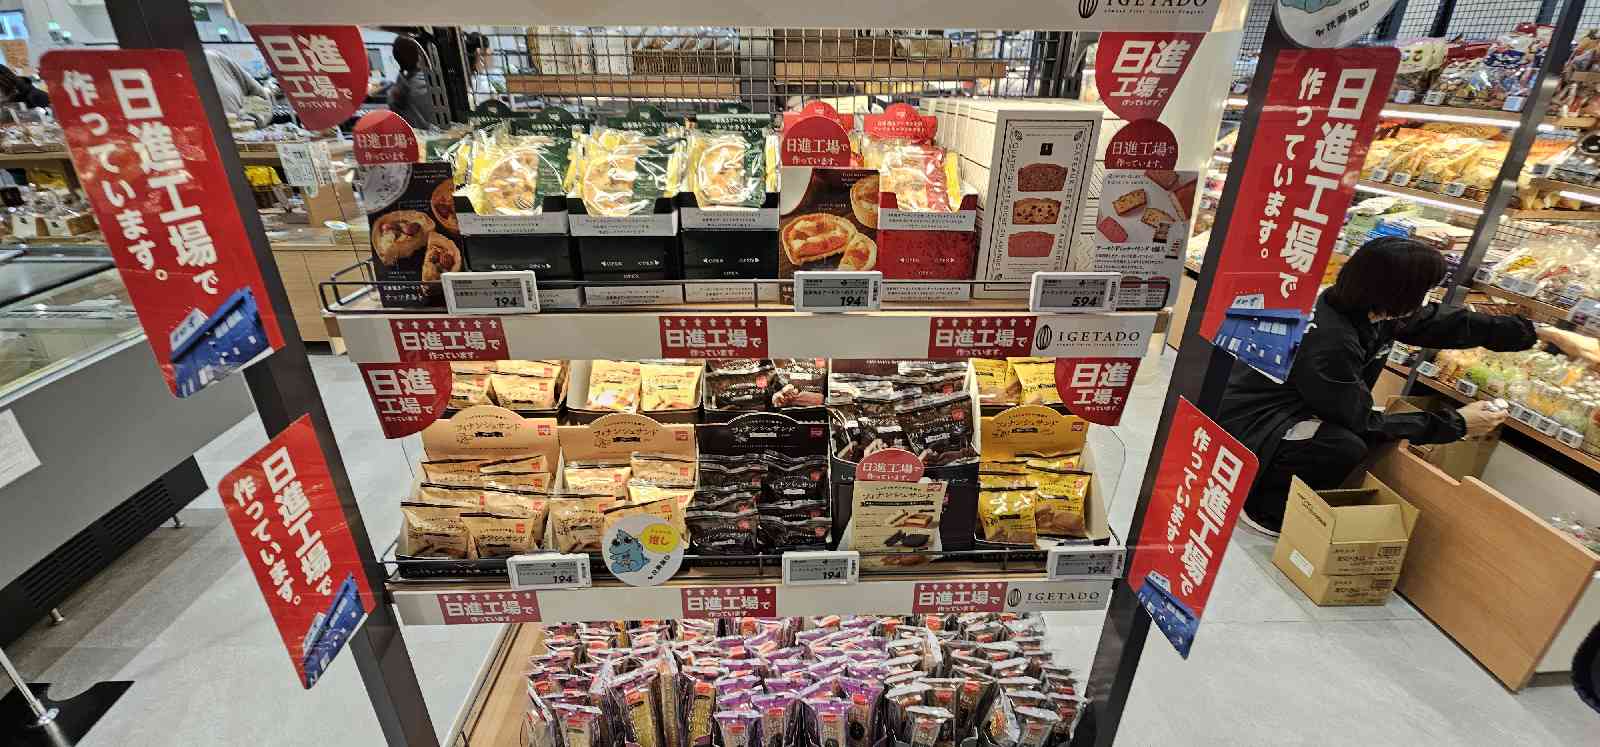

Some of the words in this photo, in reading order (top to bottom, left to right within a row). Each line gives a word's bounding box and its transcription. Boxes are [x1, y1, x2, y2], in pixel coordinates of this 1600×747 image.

[261, 35, 351, 74] 日進
[1112, 40, 1191, 75] 日進
[287, 76, 353, 101] 工場で
[1110, 77, 1168, 98] 工場で
[355, 132, 415, 149] 日進工場で
[786, 138, 848, 155] 日進工場で
[1111, 142, 1175, 157] 日進工場で
[1258, 68, 1324, 259] 作っています。
[63, 70, 169, 282] 作っています。
[109, 68, 221, 295] 日進工場で
[1279, 68, 1377, 297] 日進工場で
[495, 297, 518, 307] 194
[840, 296, 861, 306] 194
[1072, 297, 1098, 306] 594
[400, 331, 501, 352] 日進工場で
[665, 330, 762, 350] 日進工場で
[934, 328, 1028, 348] 日進工場で
[1058, 331, 1140, 342] IGETADO
[428, 352, 479, 361] 作っています。
[690, 350, 738, 358] 作っています。
[957, 349, 1005, 357] 作っています。
[367, 368, 437, 397] 日進
[1071, 361, 1132, 388] 日進
[377, 398, 434, 415] 工場で
[1073, 390, 1122, 405] 工場で
[1167, 427, 1213, 555] 作っています。
[262, 446, 332, 596] 日進工場で
[1180, 445, 1244, 597] 日進工場で
[233, 475, 302, 606] 作っています。
[688, 595, 771, 612] 日進工場で
[918, 591, 1000, 607] 日進工場で
[1027, 592, 1099, 601] IGETADO
[446, 601, 535, 617] 日進工場で
